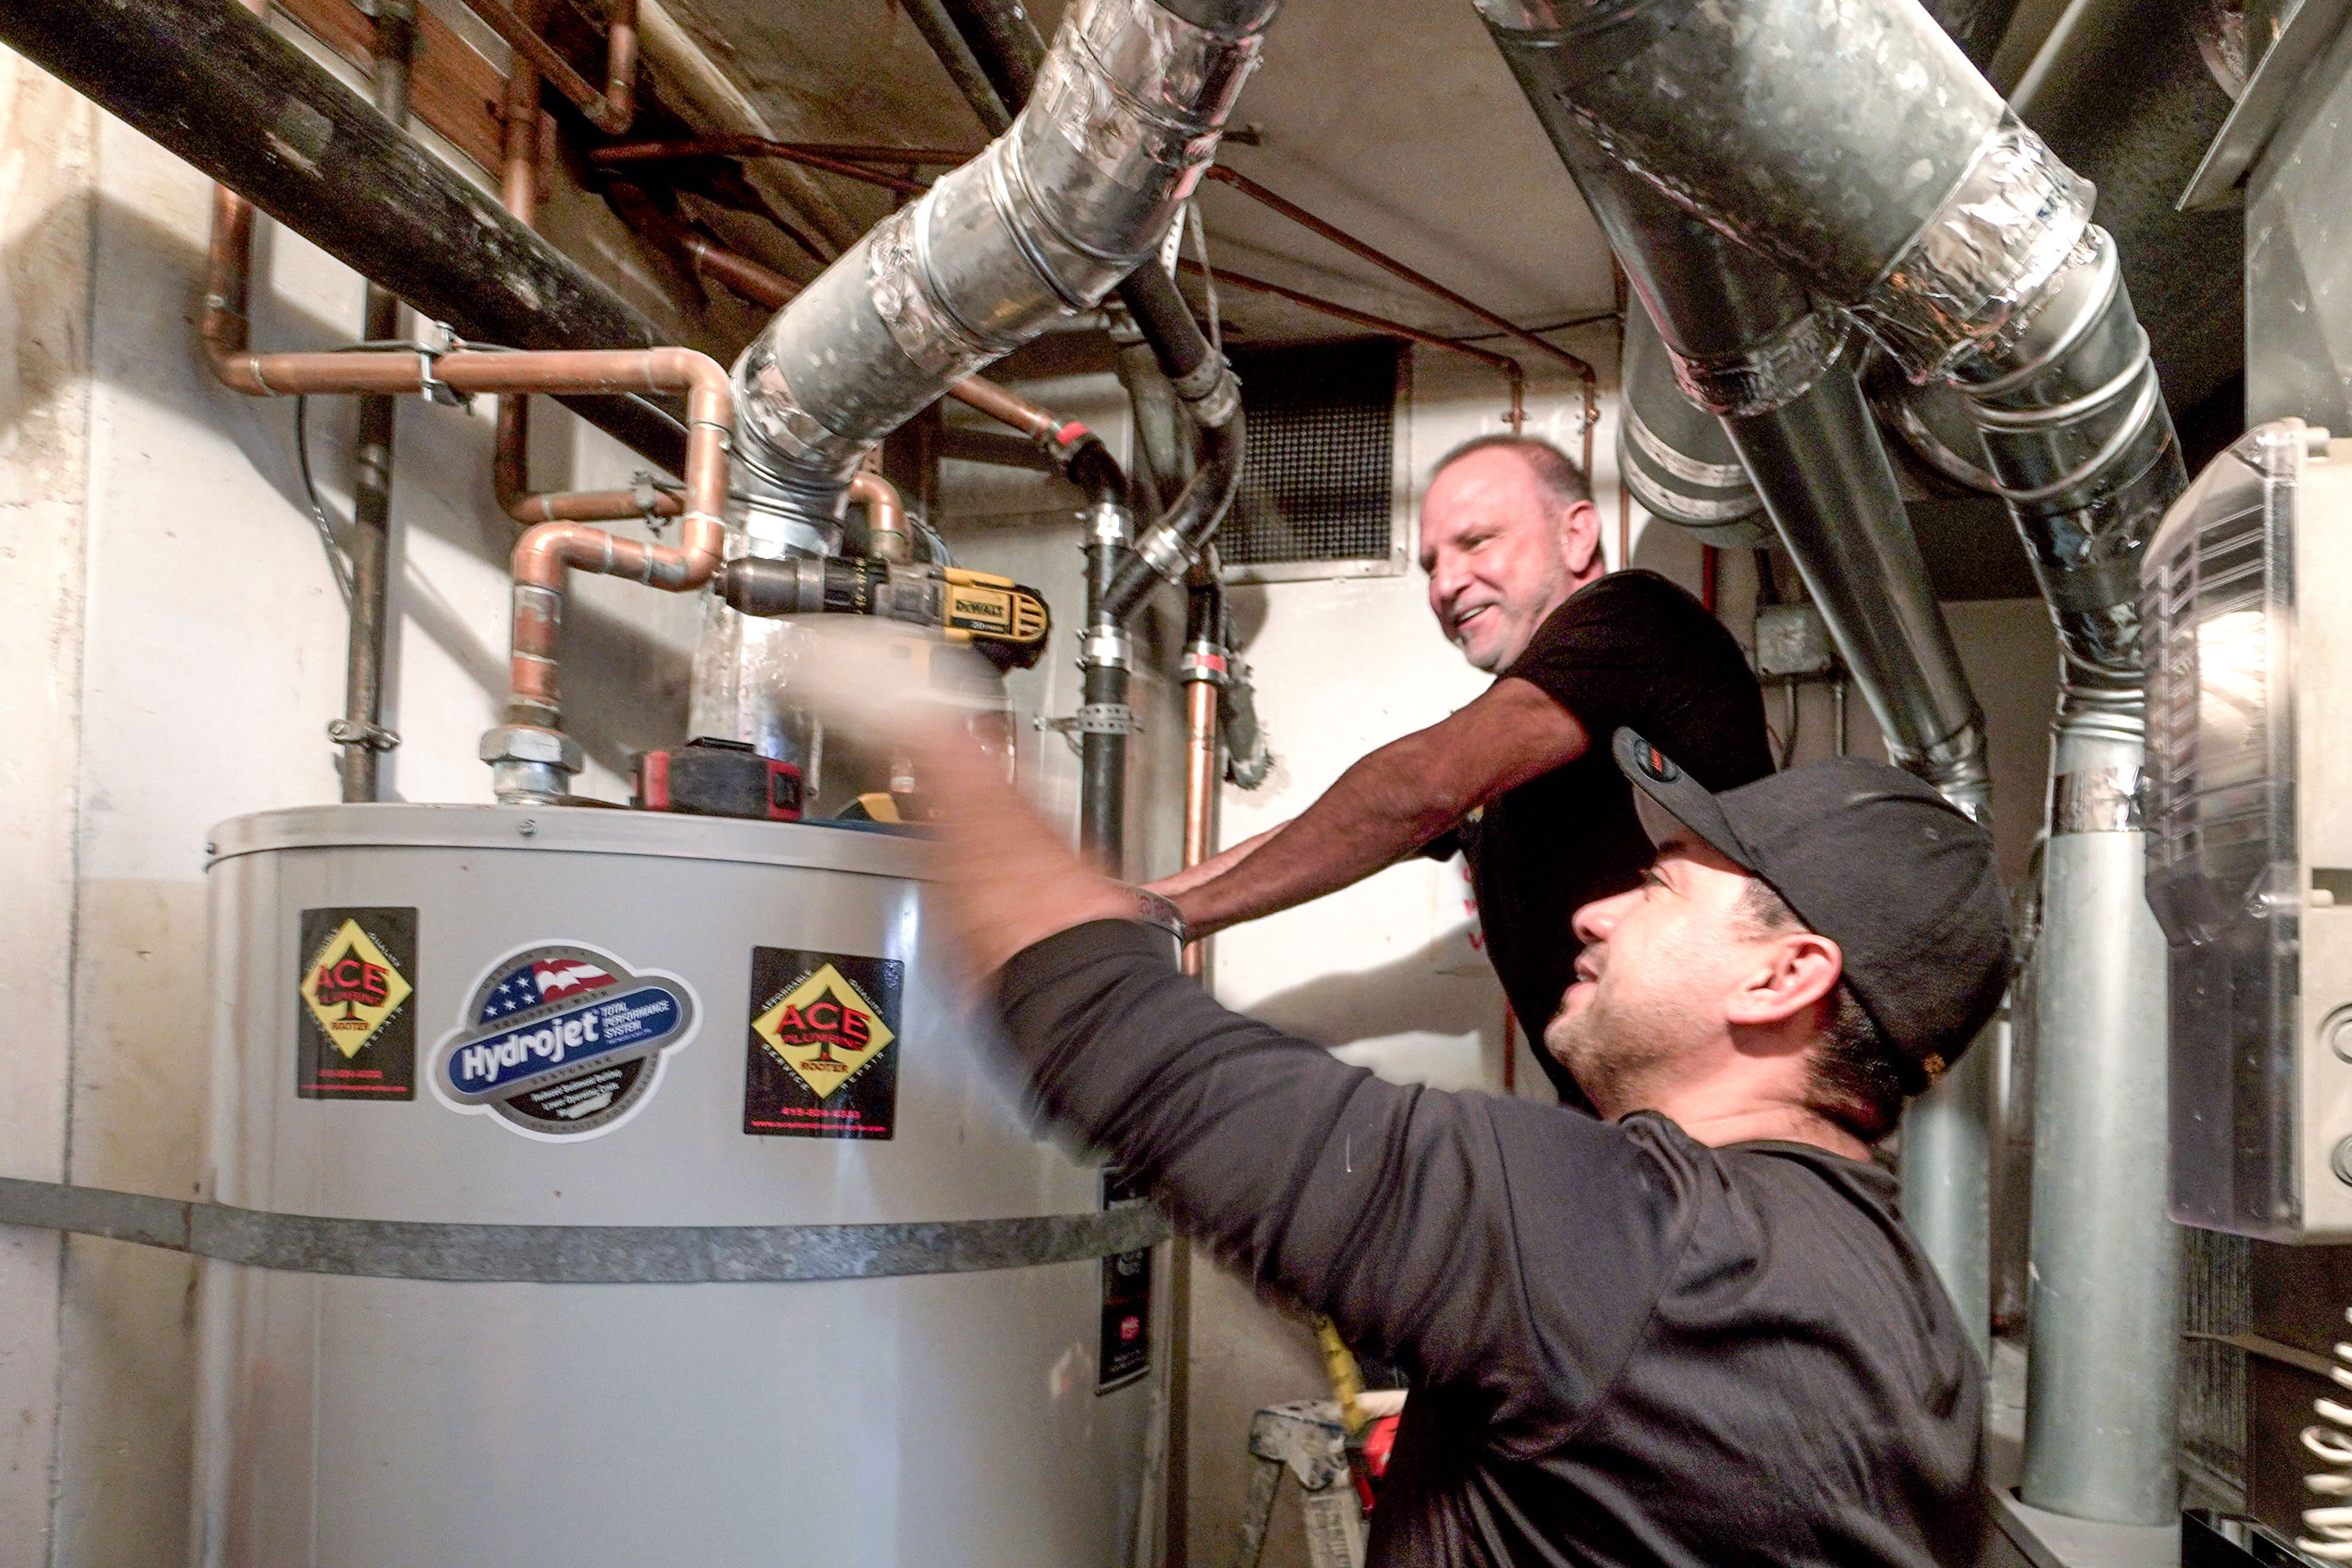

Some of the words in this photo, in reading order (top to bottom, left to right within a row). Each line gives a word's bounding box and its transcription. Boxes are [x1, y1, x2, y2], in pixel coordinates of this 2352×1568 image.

[316, 958, 390, 997] ACE
[601, 1001, 628, 1017] TOTAL
[602, 999, 670, 1028] PERFORMANCE
[775, 1002, 871, 1043] ACE
[462, 1011, 599, 1083] Hydrojet
[602, 1020, 642, 1039] SYSTEM
[761, 1043, 811, 1092] SERVICE
[800, 1061, 849, 1073] ROOTER
[840, 1052, 885, 1091] REPAIR
